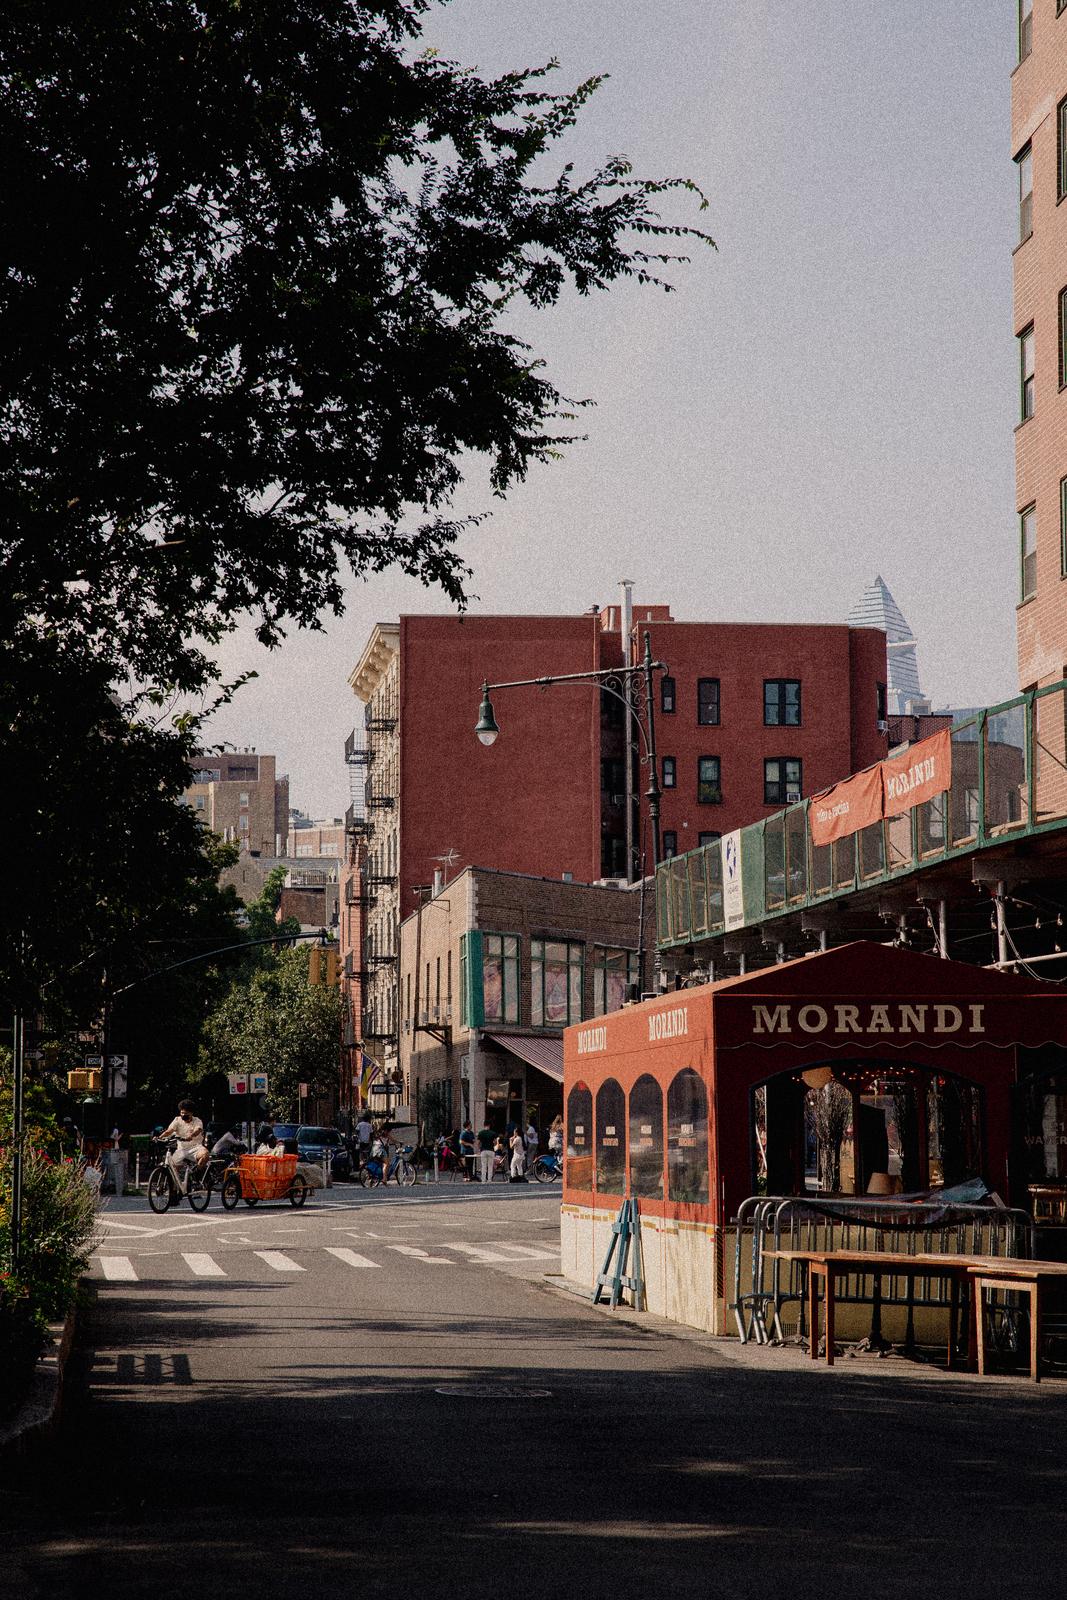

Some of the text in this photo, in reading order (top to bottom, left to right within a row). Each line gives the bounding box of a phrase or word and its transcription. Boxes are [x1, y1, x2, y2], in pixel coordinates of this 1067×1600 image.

[887, 756, 935, 800] MORANDI
[648, 1007, 688, 1041] MORANDI
[752, 1004, 985, 1033] MORANDI
[577, 1026, 607, 1054] MORANDI
